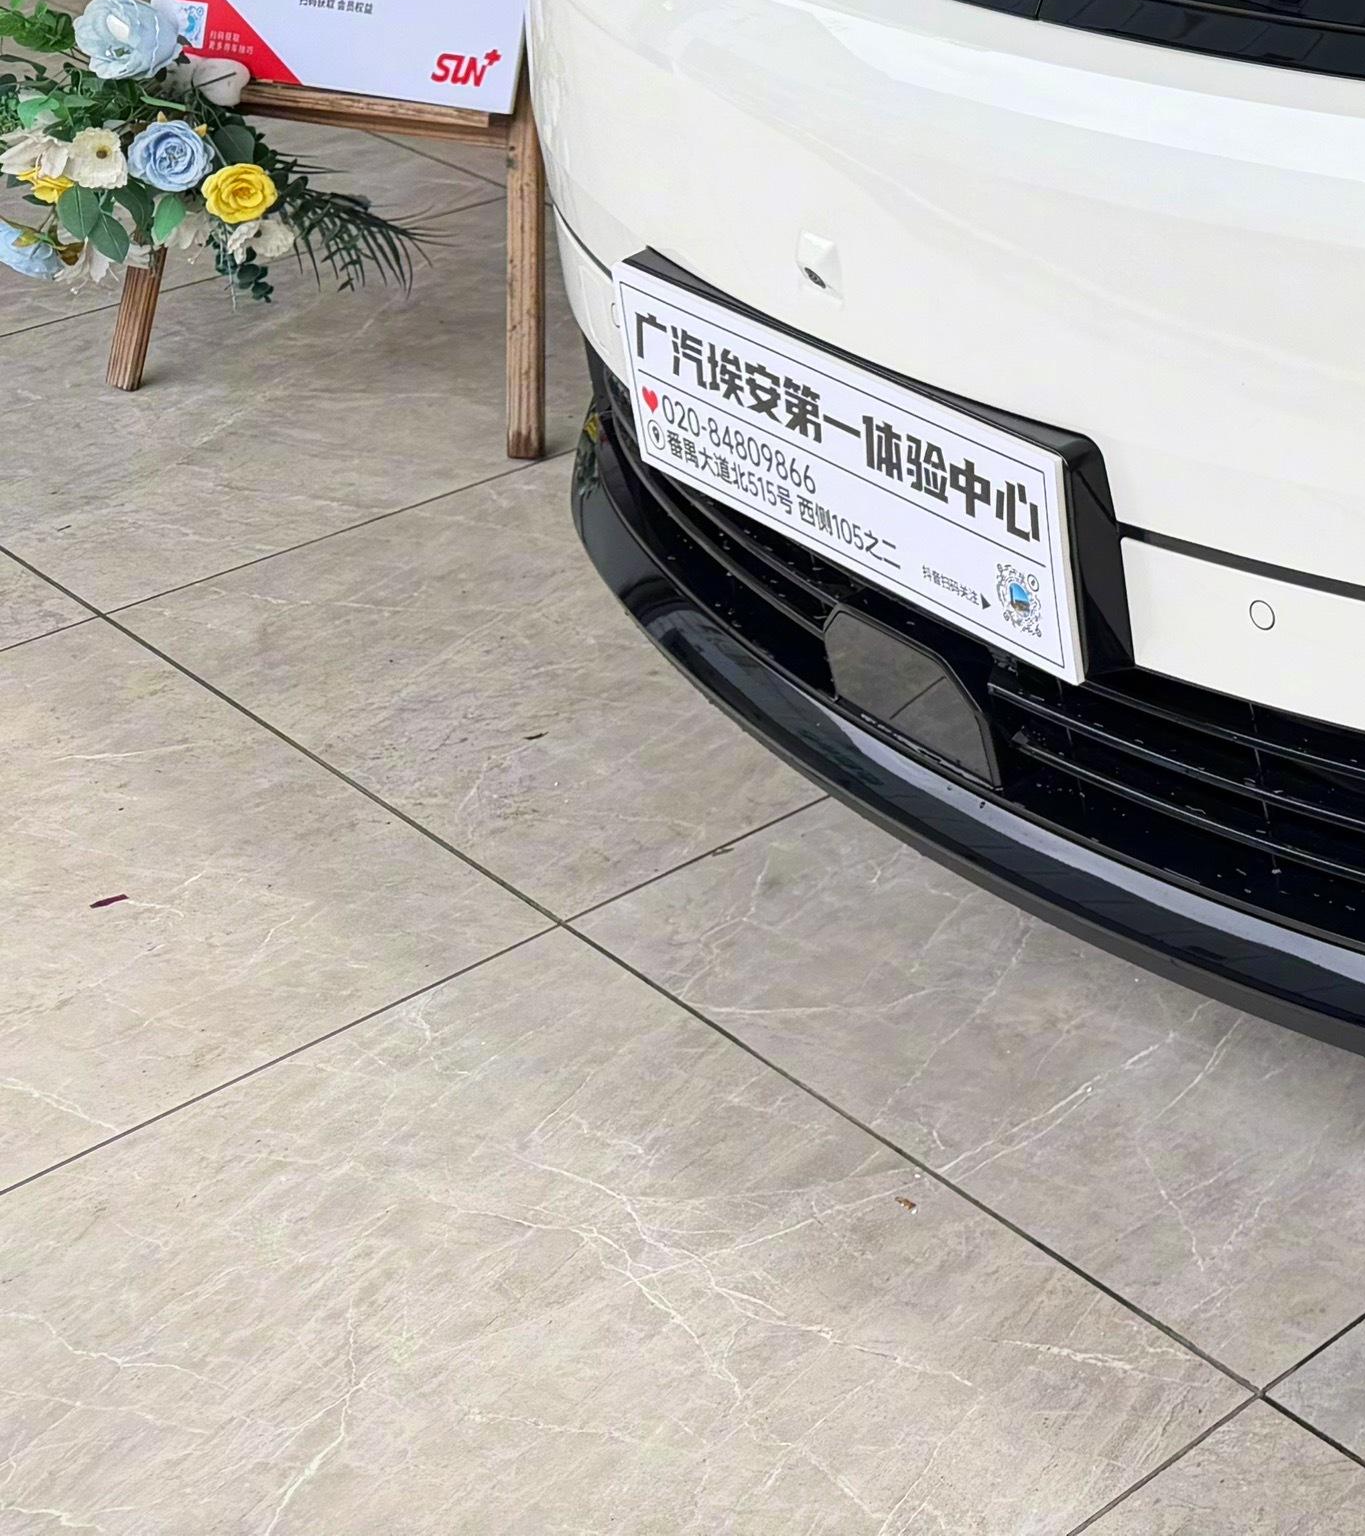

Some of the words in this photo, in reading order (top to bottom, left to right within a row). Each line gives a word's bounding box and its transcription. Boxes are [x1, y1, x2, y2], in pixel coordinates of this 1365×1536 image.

[634, 311, 1042, 543] 广汽埃安第一体验中心
[662, 394, 817, 494] 020-84809866
[666, 429, 793, 515] 番禺大道北515号
[796, 493, 902, 570] 西侧105之二
